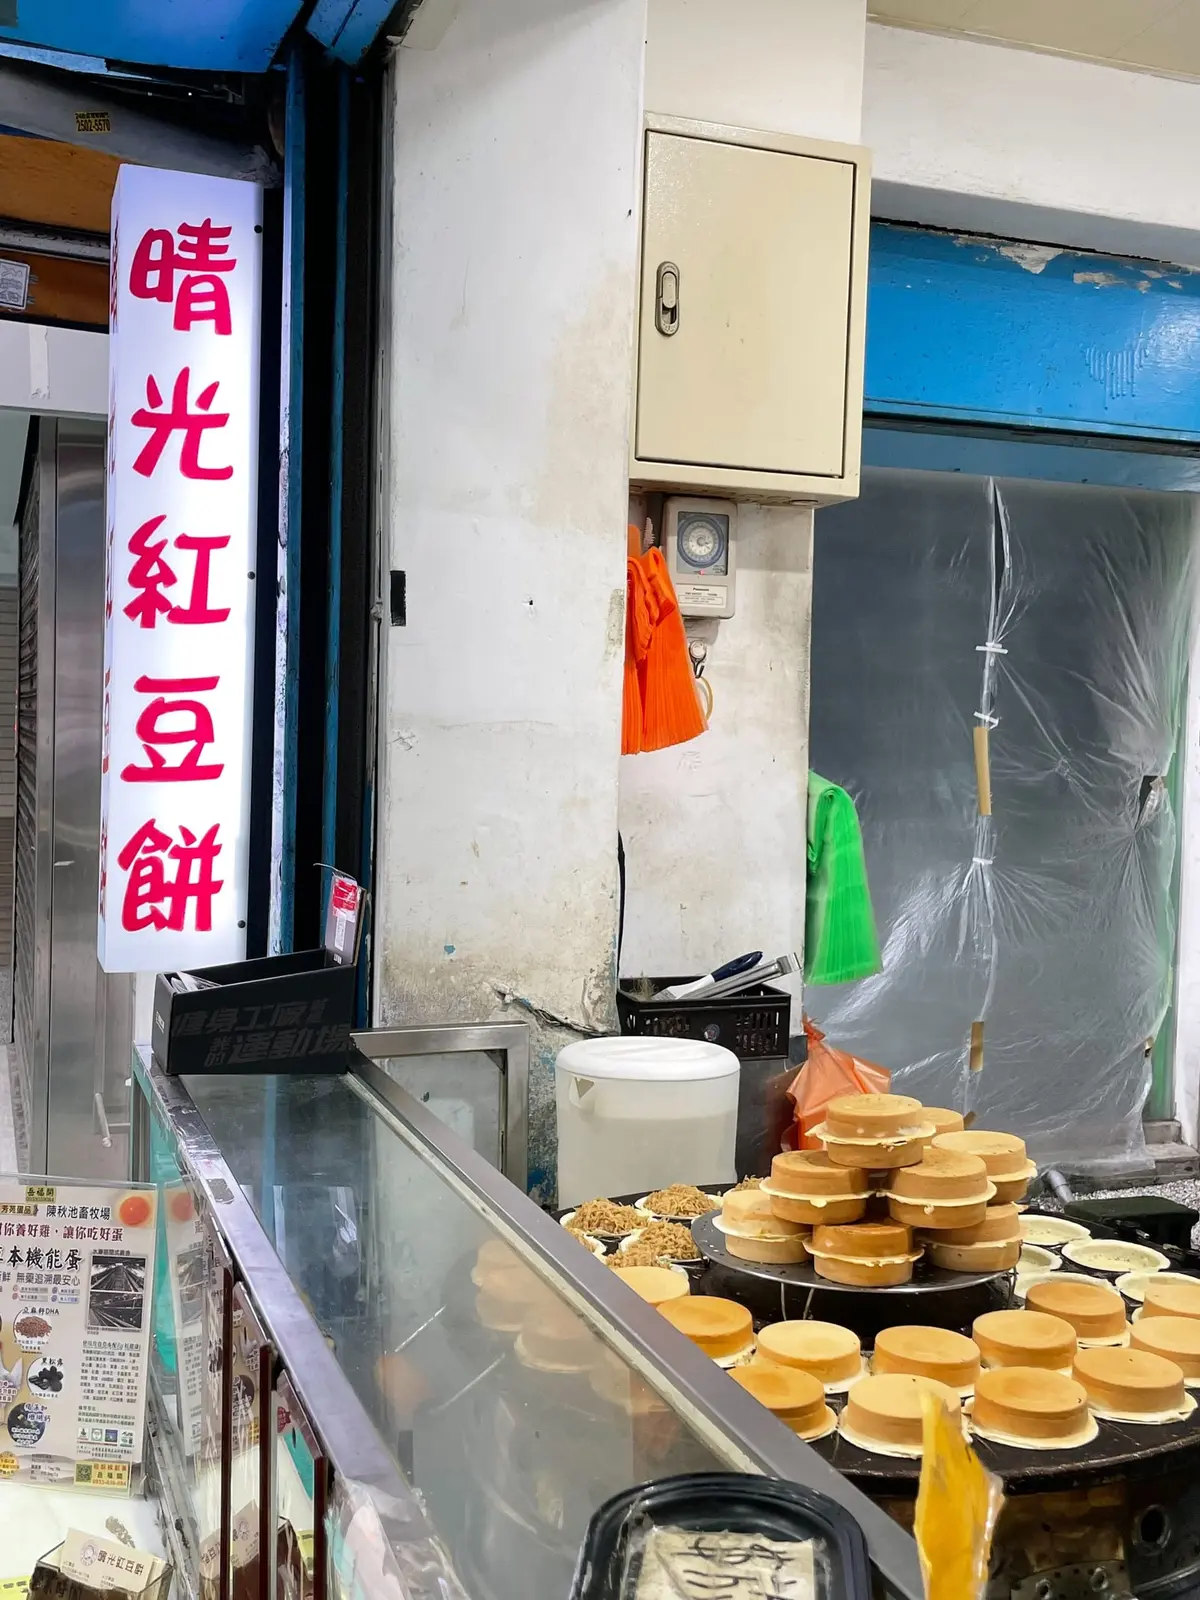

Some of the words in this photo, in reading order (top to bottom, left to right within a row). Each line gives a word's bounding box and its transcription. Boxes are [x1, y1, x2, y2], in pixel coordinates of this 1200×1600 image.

[118, 217, 237, 933] 晴光紅豆餅
[46, 1205, 111, 1220] 陳秋池畜牧場
